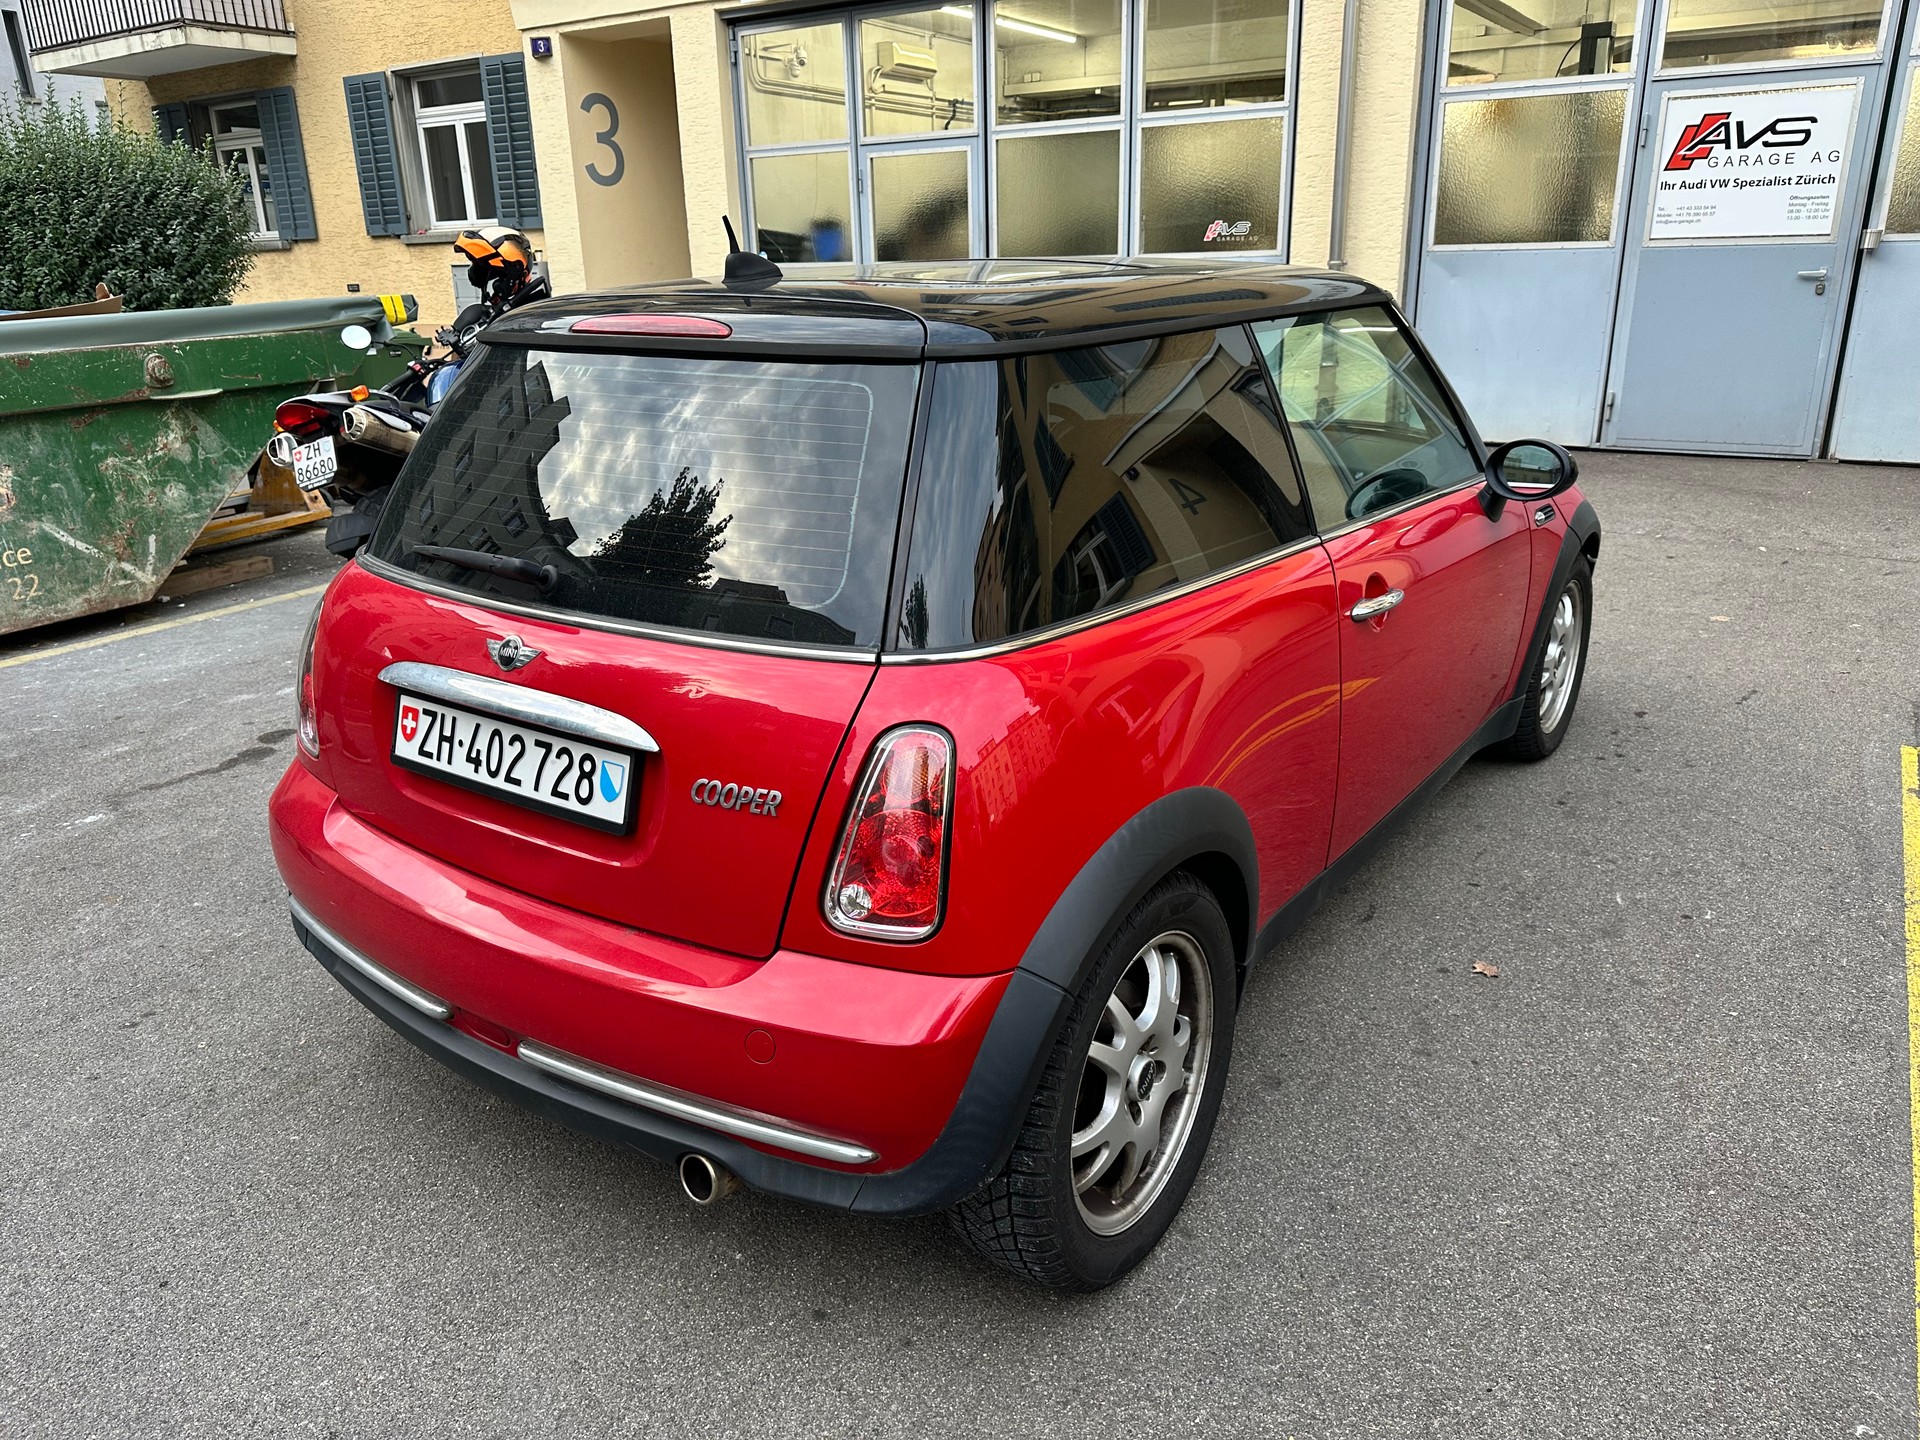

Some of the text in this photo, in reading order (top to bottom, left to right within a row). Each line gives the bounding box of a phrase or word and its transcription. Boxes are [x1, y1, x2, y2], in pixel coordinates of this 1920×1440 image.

[537, 40, 545, 53] 3
[580, 92, 625, 187] 3
[1683, 115, 1818, 151] AVS
[1707, 150, 1841, 169] GARAGE AG
[1660, 173, 1836, 191] Ihr Audi VW Spezialist Zürich
[1212, 221, 1251, 236] AVS
[304, 441, 322, 461] ZH
[297, 456, 334, 483] 86680
[0, 547, 33, 569] ce
[499, 646, 518, 659] MINI
[690, 778, 782, 817] COOPER
